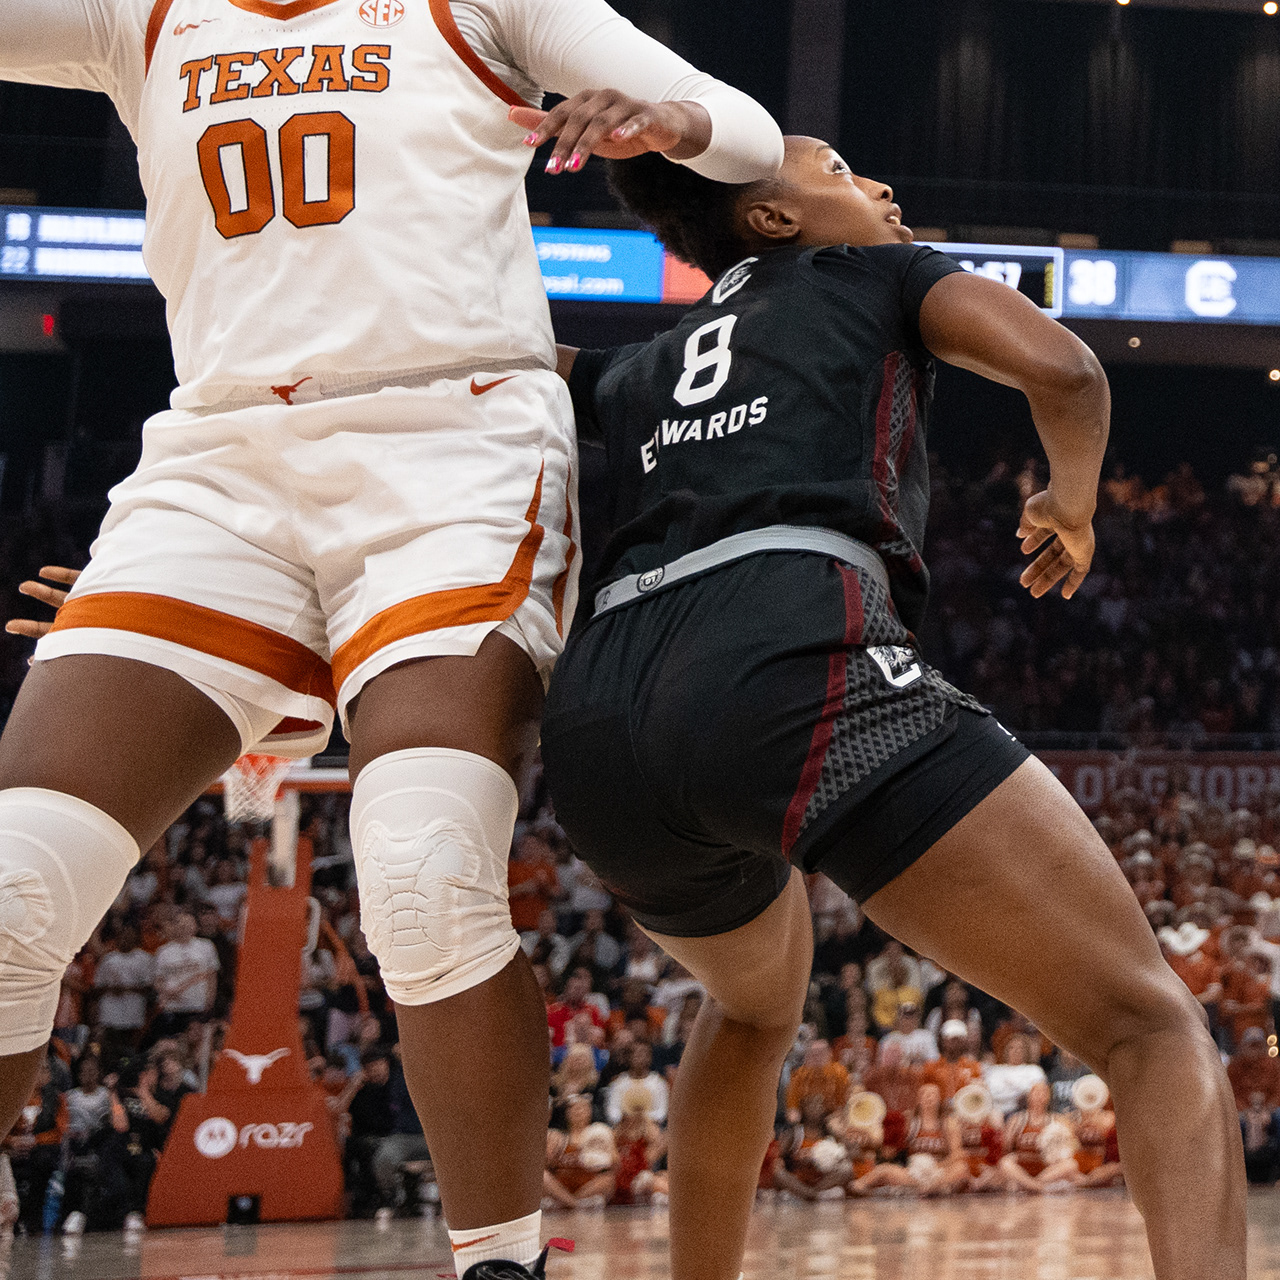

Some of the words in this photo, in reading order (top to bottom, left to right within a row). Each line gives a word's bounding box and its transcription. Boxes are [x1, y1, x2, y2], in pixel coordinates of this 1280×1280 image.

[180, 44, 391, 113] TEXAS
[197, 111, 356, 239] 00
[673, 314, 738, 407] 8
[640, 396, 768, 474] EWARDS
[239, 1122, 314, 1149] razr
